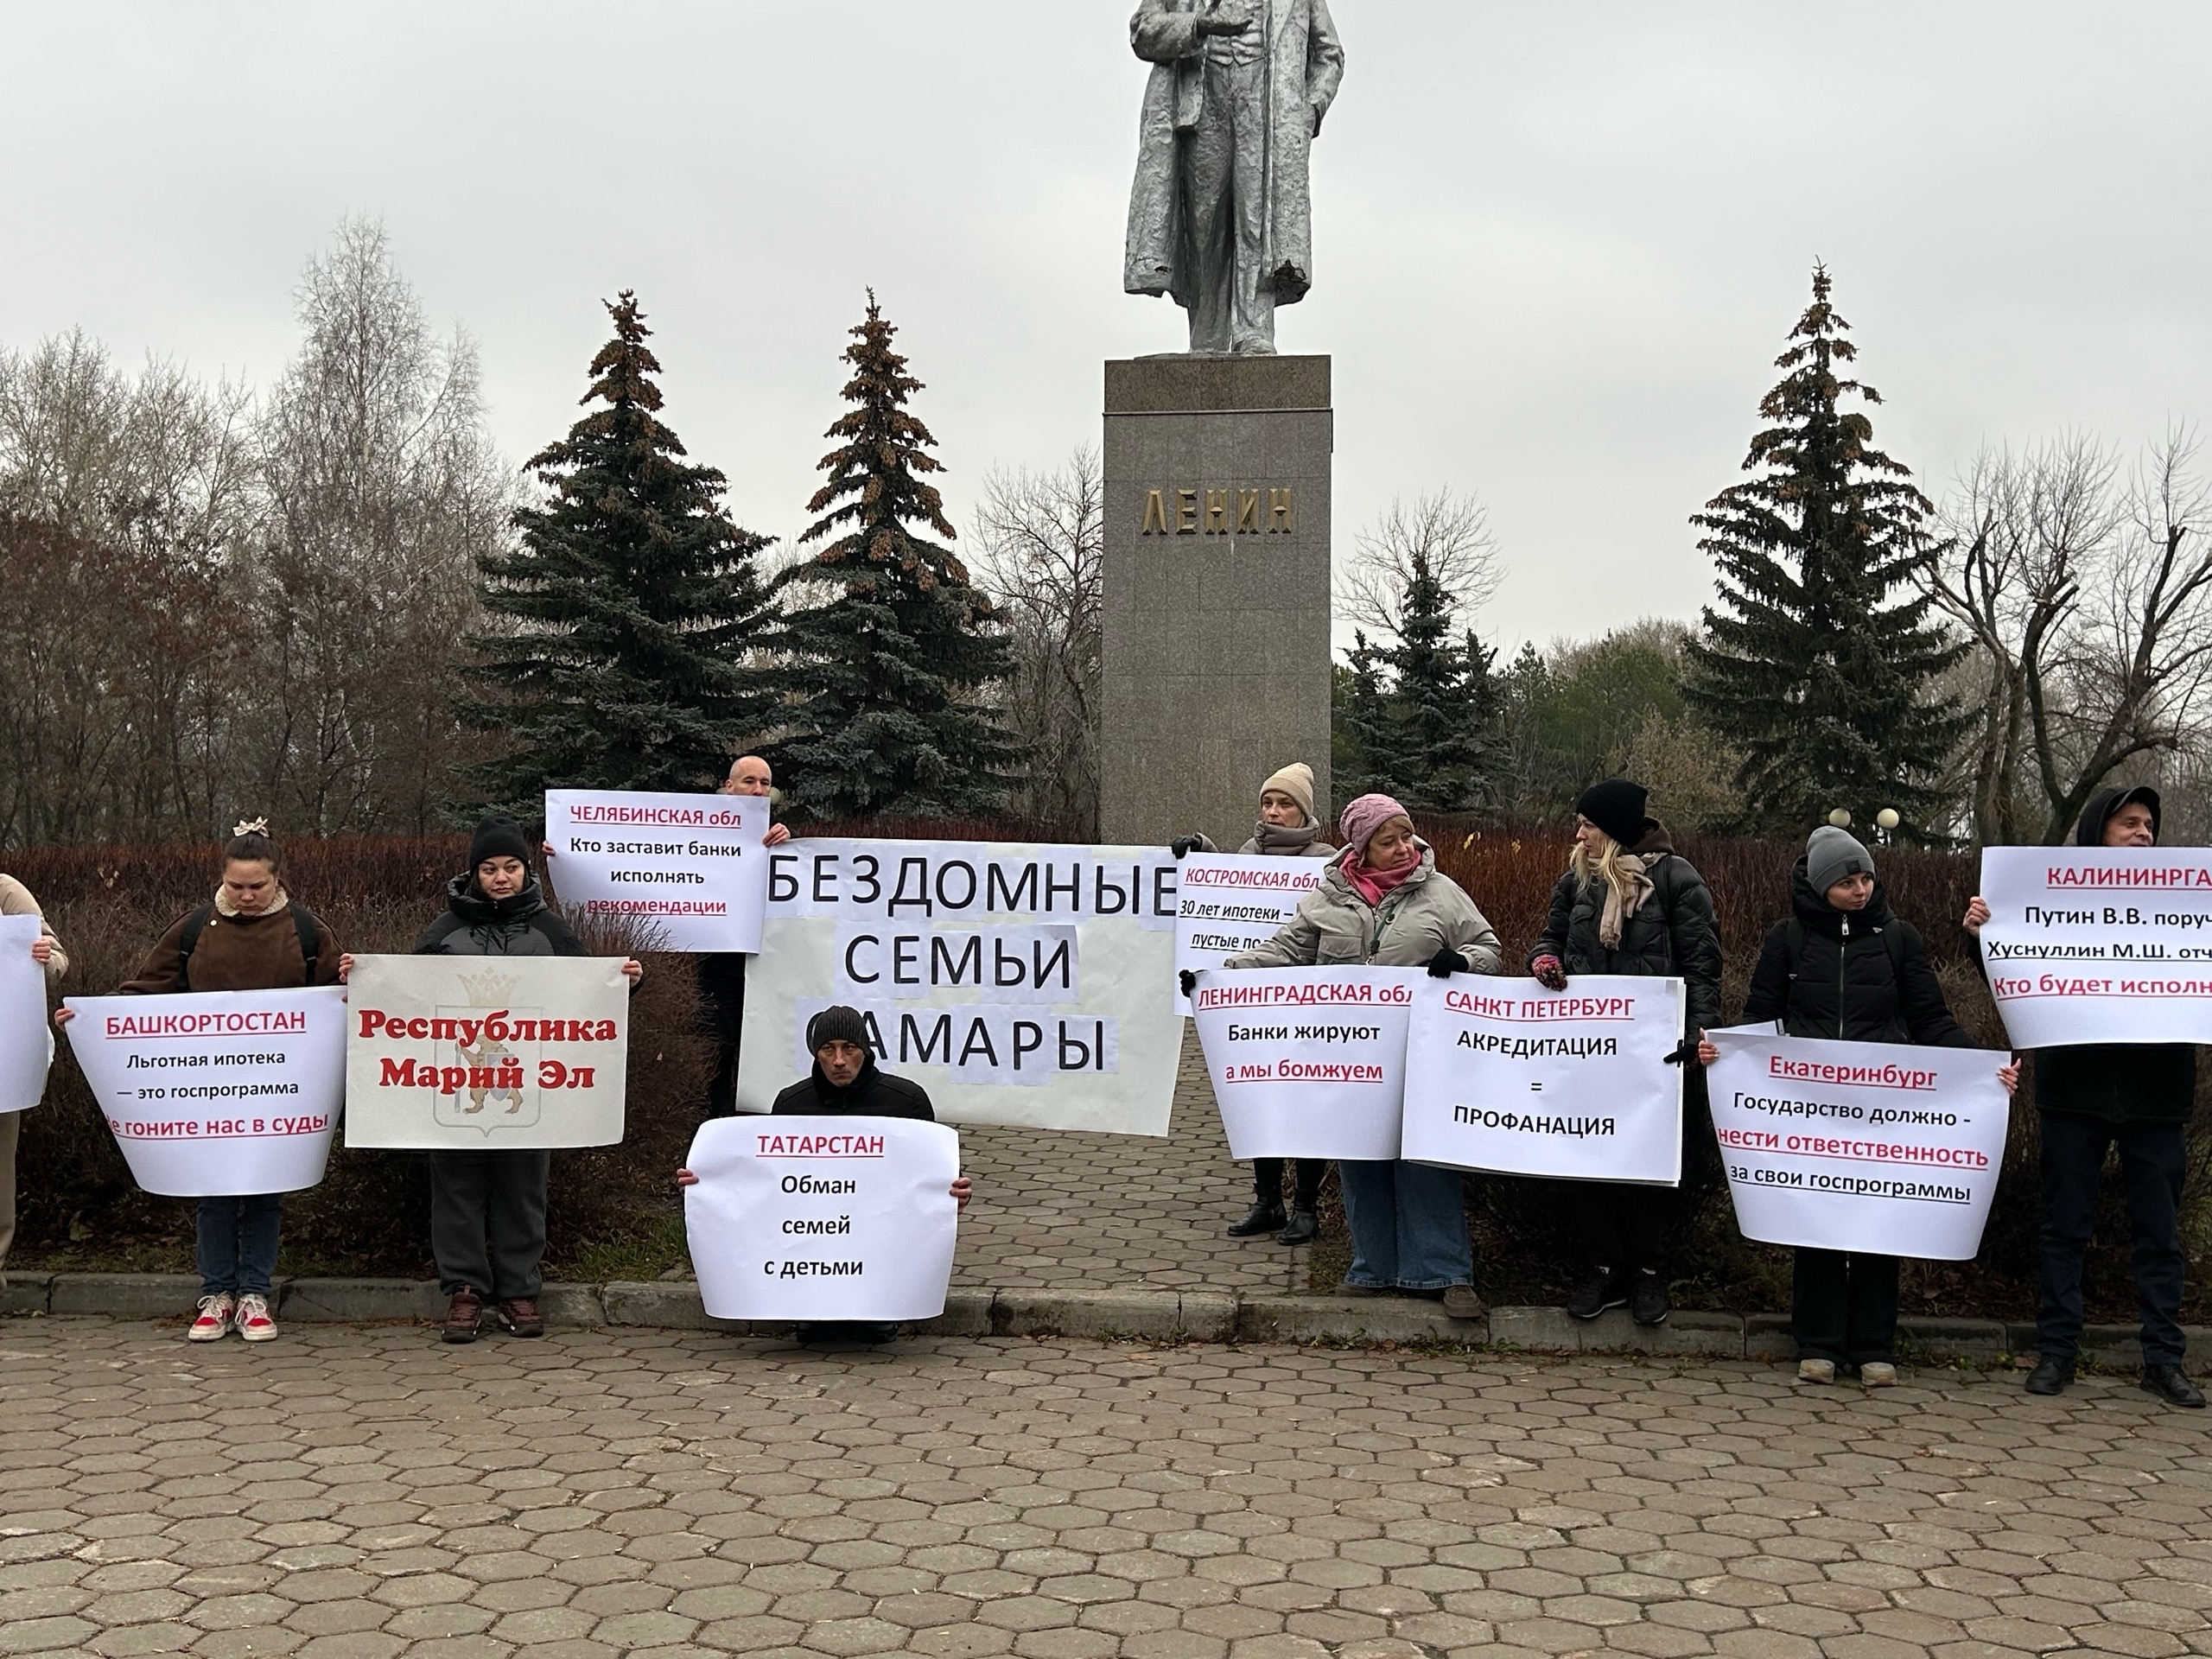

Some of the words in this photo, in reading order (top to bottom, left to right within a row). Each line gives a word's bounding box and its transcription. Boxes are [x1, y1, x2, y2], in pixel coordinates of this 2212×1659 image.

[1142, 488, 1291, 535] ЛЕНИН
[570, 805, 703, 823] ЧЕЛЯБИНСКАЯ
[709, 810, 741, 826] обл
[570, 837, 601, 852] Кто
[607, 842, 683, 855] заставит
[689, 841, 741, 856] банки
[611, 870, 704, 884] исполнять
[768, 855, 1177, 918] БЕЗДОМНЫЕ
[1185, 868, 1290, 887] КОСТРОМСКАЯ
[1293, 873, 1319, 889] обл
[2048, 868, 2212, 886] КАЛИНИНРГА
[588, 899, 726, 914] рекомендации
[1180, 900, 1195, 914] 30
[1197, 905, 1220, 917] лет
[1222, 906, 1281, 920] ипотеки
[2025, 906, 2094, 927] Путин
[2103, 907, 2147, 925] В.В.
[1192, 933, 1239, 949] пустые
[1987, 941, 2105, 958] Хуснуллин
[2113, 944, 2171, 958] М.Ш.
[844, 934, 1070, 989] СЕМЬИ
[1993, 977, 2031, 995] Кто
[2039, 974, 2113, 995] будет
[1198, 984, 1372, 1007] ЛЕНИНГРАДСКАЯ
[1446, 990, 1516, 1017] САНКТ
[1522, 998, 1635, 1018] ПЕТЕРБУРГ
[107, 1012, 305, 1034] БАШКОРТОСТАН
[359, 1009, 617, 1047] Республика
[1229, 1025, 1287, 1041] Банки
[1294, 1026, 1381, 1043] жируют
[1457, 1030, 1617, 1059] АКРЕДИТАЦИЯ
[127, 1054, 208, 1068] Льготная
[215, 1052, 285, 1065] ипотека
[1226, 1066, 1235, 1079] а
[1241, 1064, 1271, 1078] мы
[1278, 1059, 1382, 1080] бомжуем
[379, 1058, 524, 1095] Марий
[537, 1060, 594, 1089] Эл
[1770, 1055, 1937, 1089] Екатеринбург
[138, 1087, 165, 1099] это
[171, 1084, 299, 1100] госпрограмма
[1733, 1092, 1864, 1119] Государство
[1870, 1108, 1957, 1126] должно
[125, 1120, 198, 1135] гоните
[207, 1119, 245, 1134] нас
[252, 1119, 264, 1133] в
[272, 1114, 328, 1135] суды
[1453, 1105, 1615, 1139] ПРОФАНАЦИЯ
[757, 1135, 884, 1154] ТАТАРСТАН
[1718, 1128, 1779, 1148] нести
[1787, 1135, 1989, 1166] ответственность
[781, 1175, 855, 1194] Обман
[1731, 1165, 1747, 1180] за
[1754, 1166, 1802, 1185] свои
[1809, 1174, 1971, 1201] госпрограммы
[782, 1215, 850, 1234] семей
[764, 1261, 775, 1274] с
[780, 1261, 863, 1279] детьми
